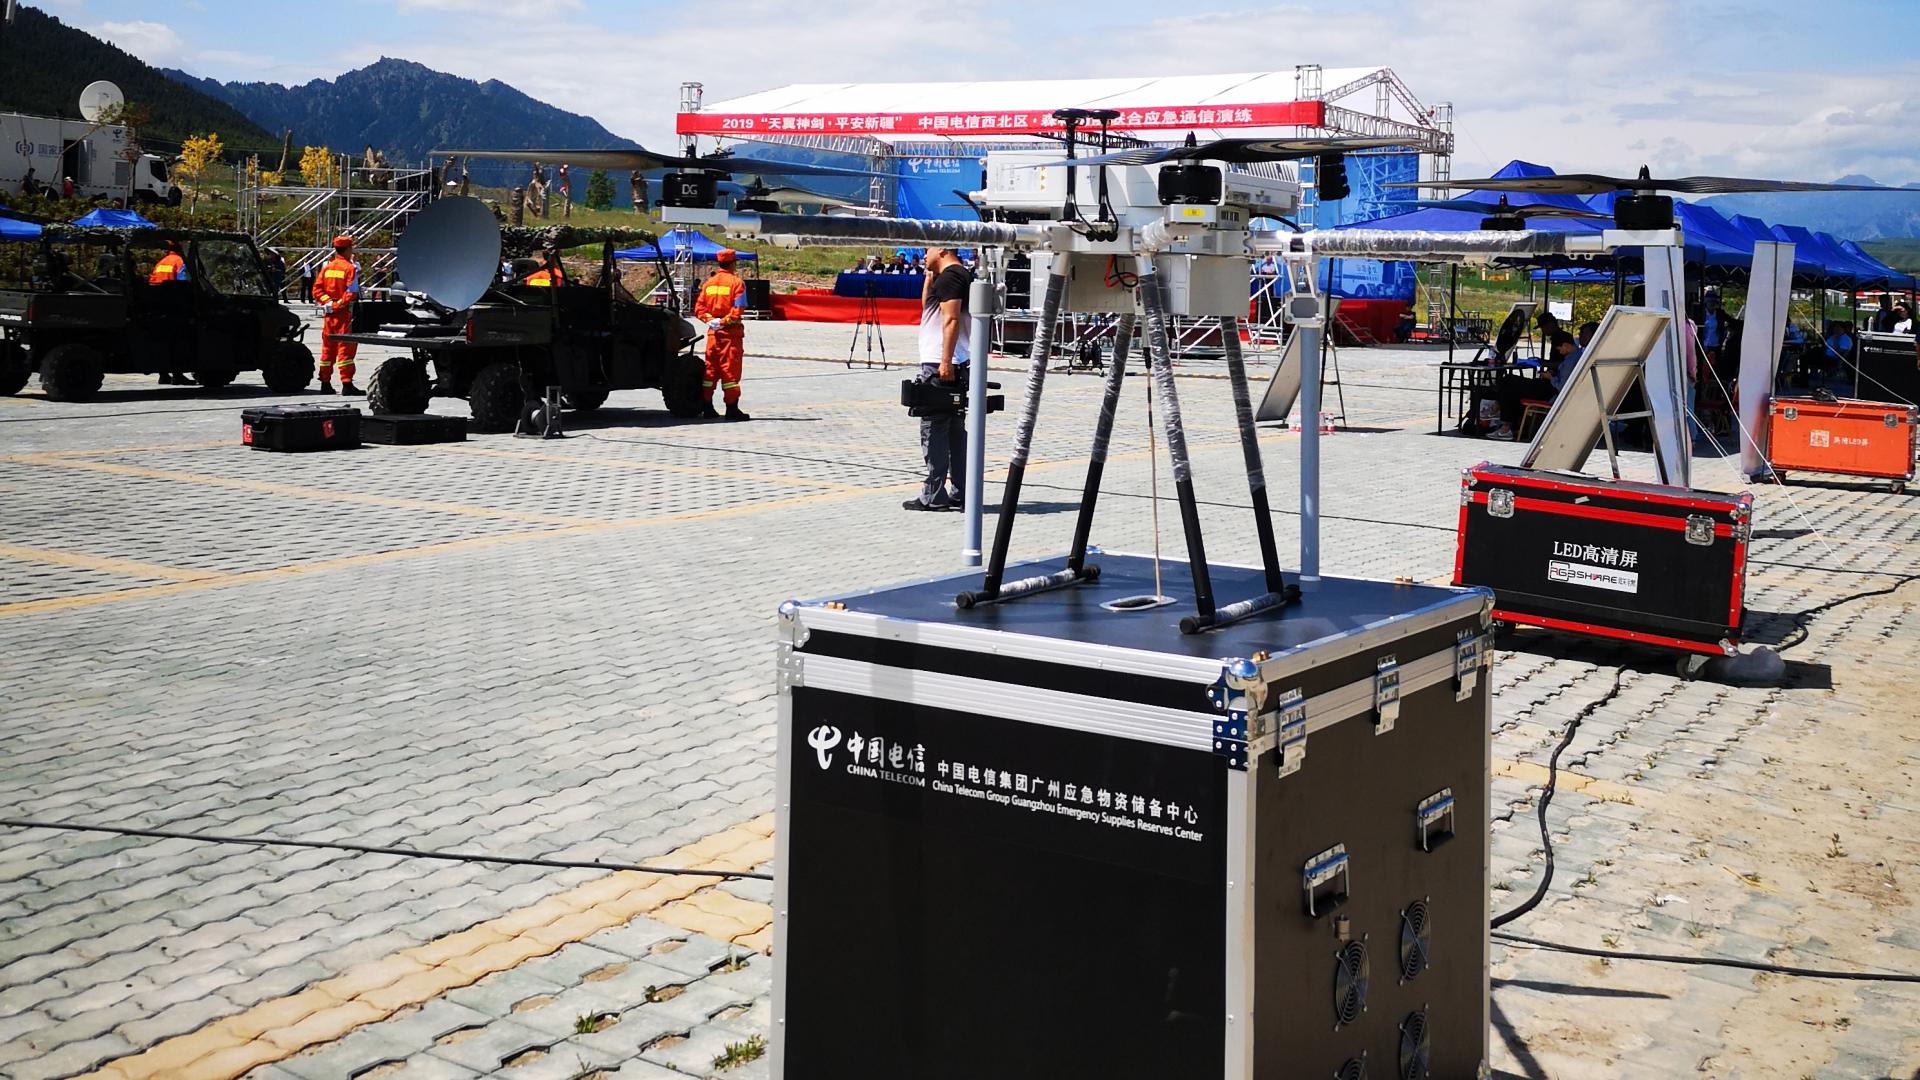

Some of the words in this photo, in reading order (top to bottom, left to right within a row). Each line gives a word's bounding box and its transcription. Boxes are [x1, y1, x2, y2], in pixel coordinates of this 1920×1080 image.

[722, 118, 754, 129] 2019
[682, 184, 698, 195] DG
[1553, 541, 1638, 568] LED高清屏
[847, 731, 925, 773] 中国电信
[847, 764, 878, 778] CHINA
[879, 769, 926, 788] TELECOM
[938, 760, 1199, 825] 中国电信集团广州应急物资储备中心
[932, 780, 953, 793] China
[955, 784, 985, 799] Telecom
[986, 790, 1010, 806] Group
[1012, 795, 1056, 812] Guangzhou
[1057, 803, 1101, 824] Emergency
[1102, 811, 1136, 829] Supplies
[1137, 818, 1174, 836] Reserves
[1175, 826, 1203, 842] Center
